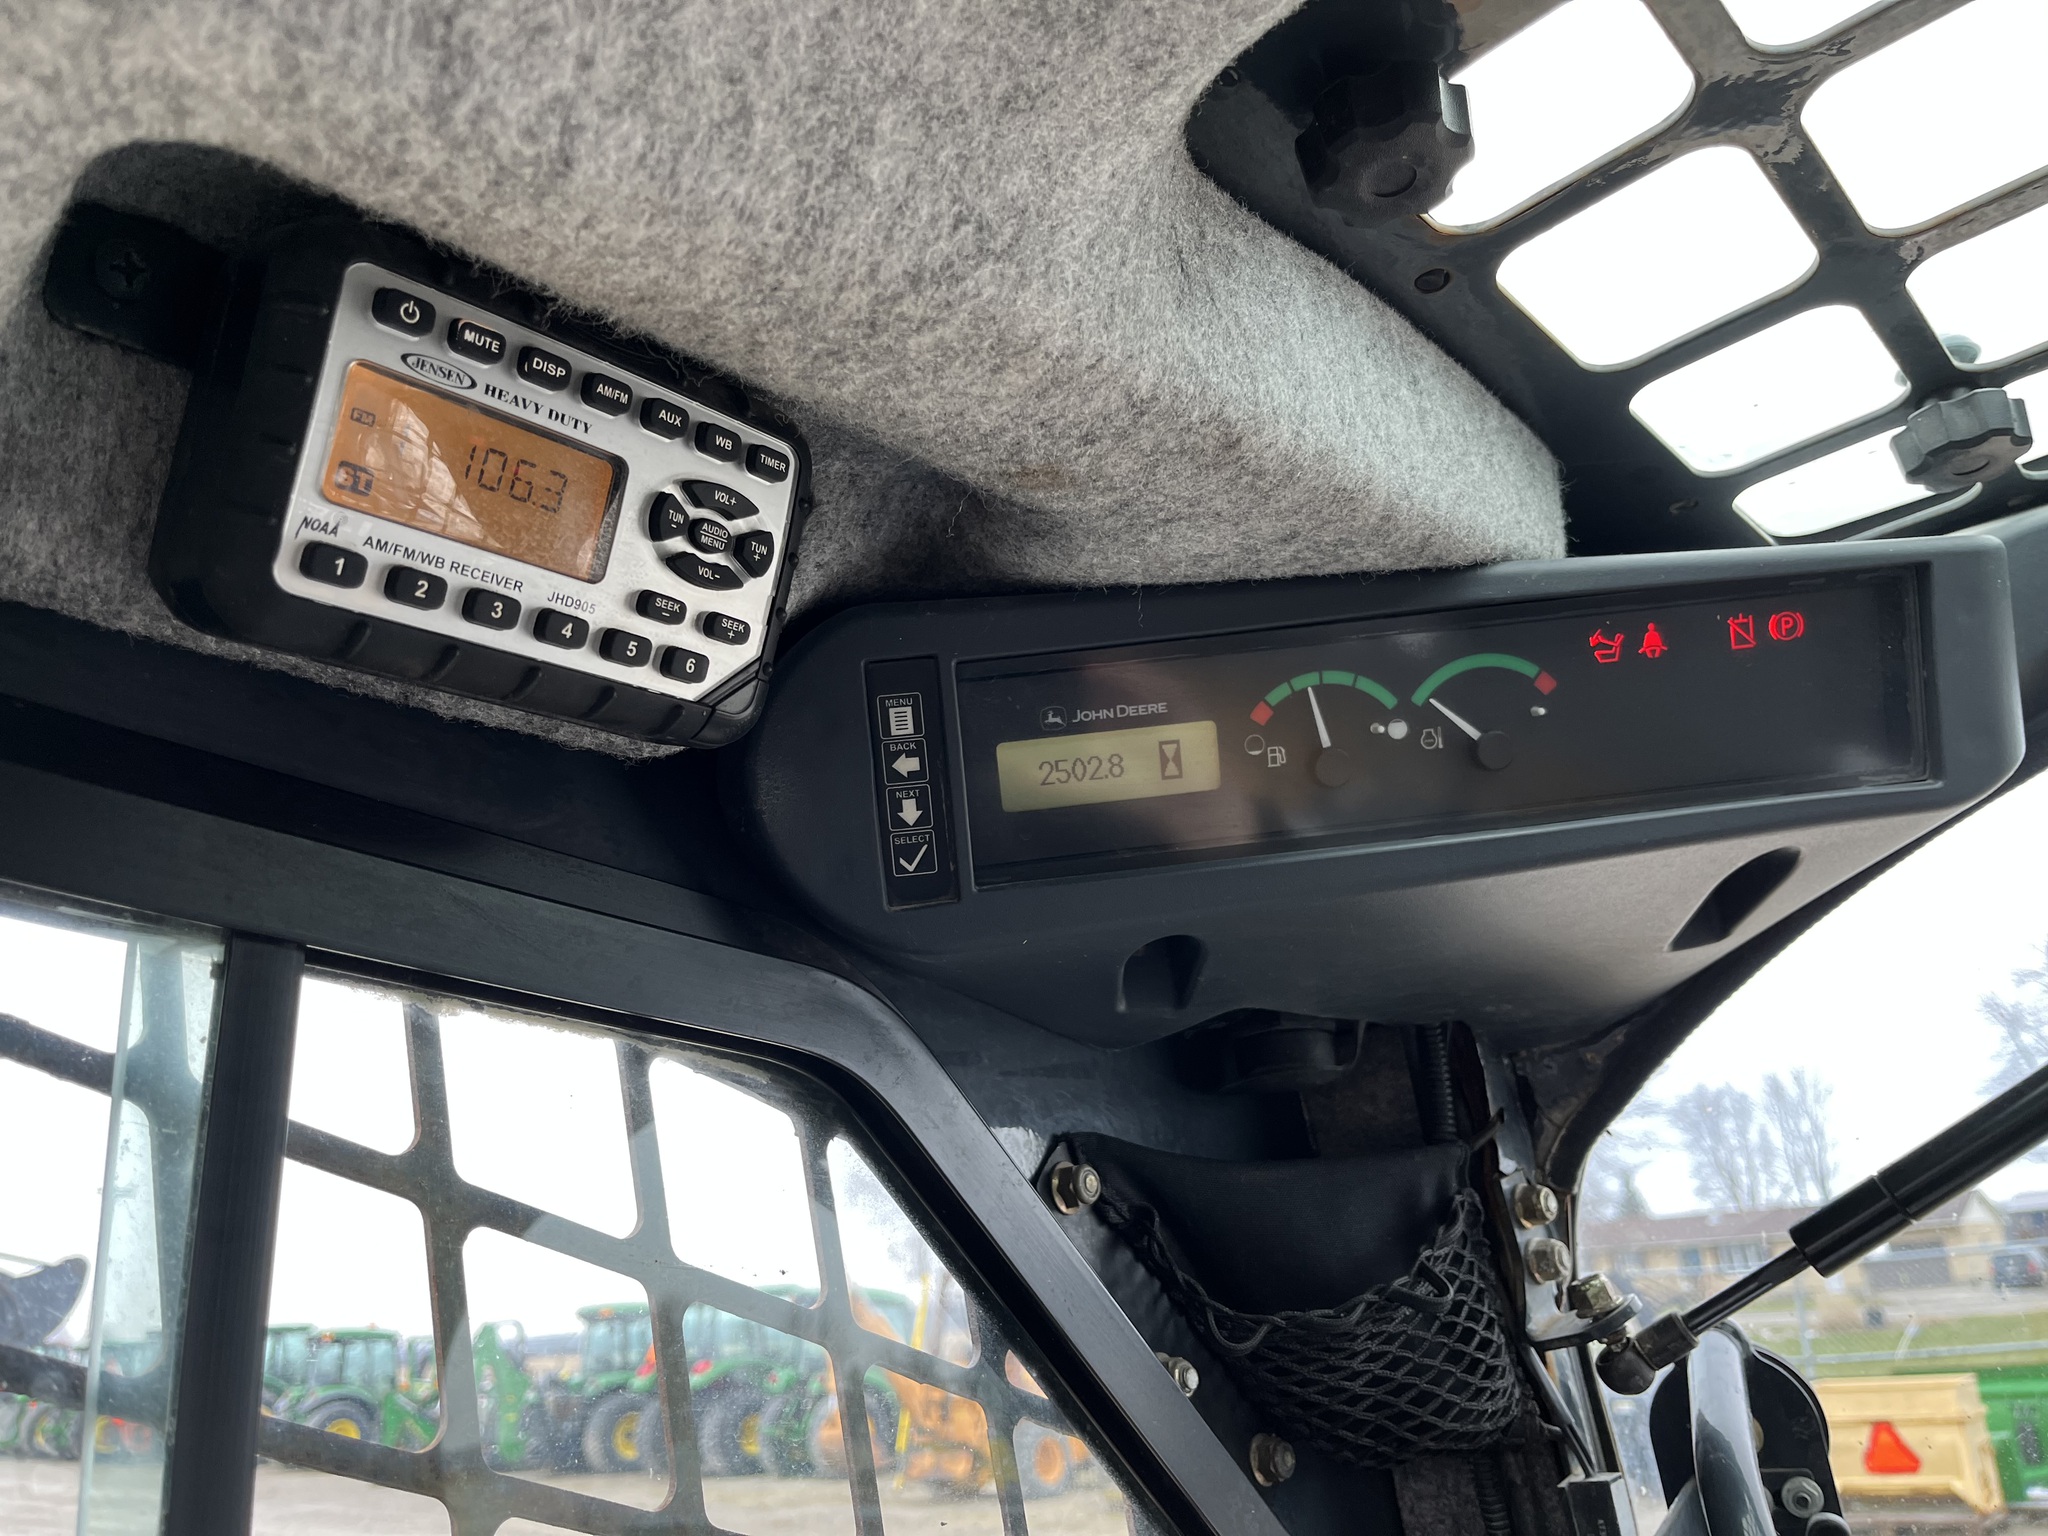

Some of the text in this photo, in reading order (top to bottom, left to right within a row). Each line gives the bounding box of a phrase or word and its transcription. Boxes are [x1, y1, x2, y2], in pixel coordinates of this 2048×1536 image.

[463, 329, 501, 353] MUTE
[411, 357, 466, 386] JENSEN
[532, 356, 566, 378] DISP
[596, 383, 629, 405] AM/FM
[483, 382, 593, 435] HEAVY DUTY
[658, 409, 683, 428] AUX
[715, 434, 733, 451] WB
[759, 453, 787, 473] TIMER
[668, 509, 685, 525] TUN
[702, 523, 728, 539] AUDIO
[700, 535, 725, 550] MENU
[751, 541, 768, 556] TUN
[334, 557, 346, 576] 1
[362, 535, 524, 593] AM/FM/WB RECEIVER
[414, 580, 429, 599] 2
[490, 601, 504, 619] 3
[547, 591, 596, 615] JHD905
[655, 597, 681, 613] SEEK
[561, 622, 573, 640] 4
[721, 618, 746, 634] SEEK
[626, 641, 638, 657] 5
[685, 658, 697, 674] 6
[885, 697, 914, 708] MENU
[1072, 702, 1168, 723] JOHN DEERE
[889, 741, 917, 752] BACK
[1038, 753, 1125, 787] 2502.8
[895, 788, 921, 799] NEXT
[893, 833, 931, 845] SELECT
